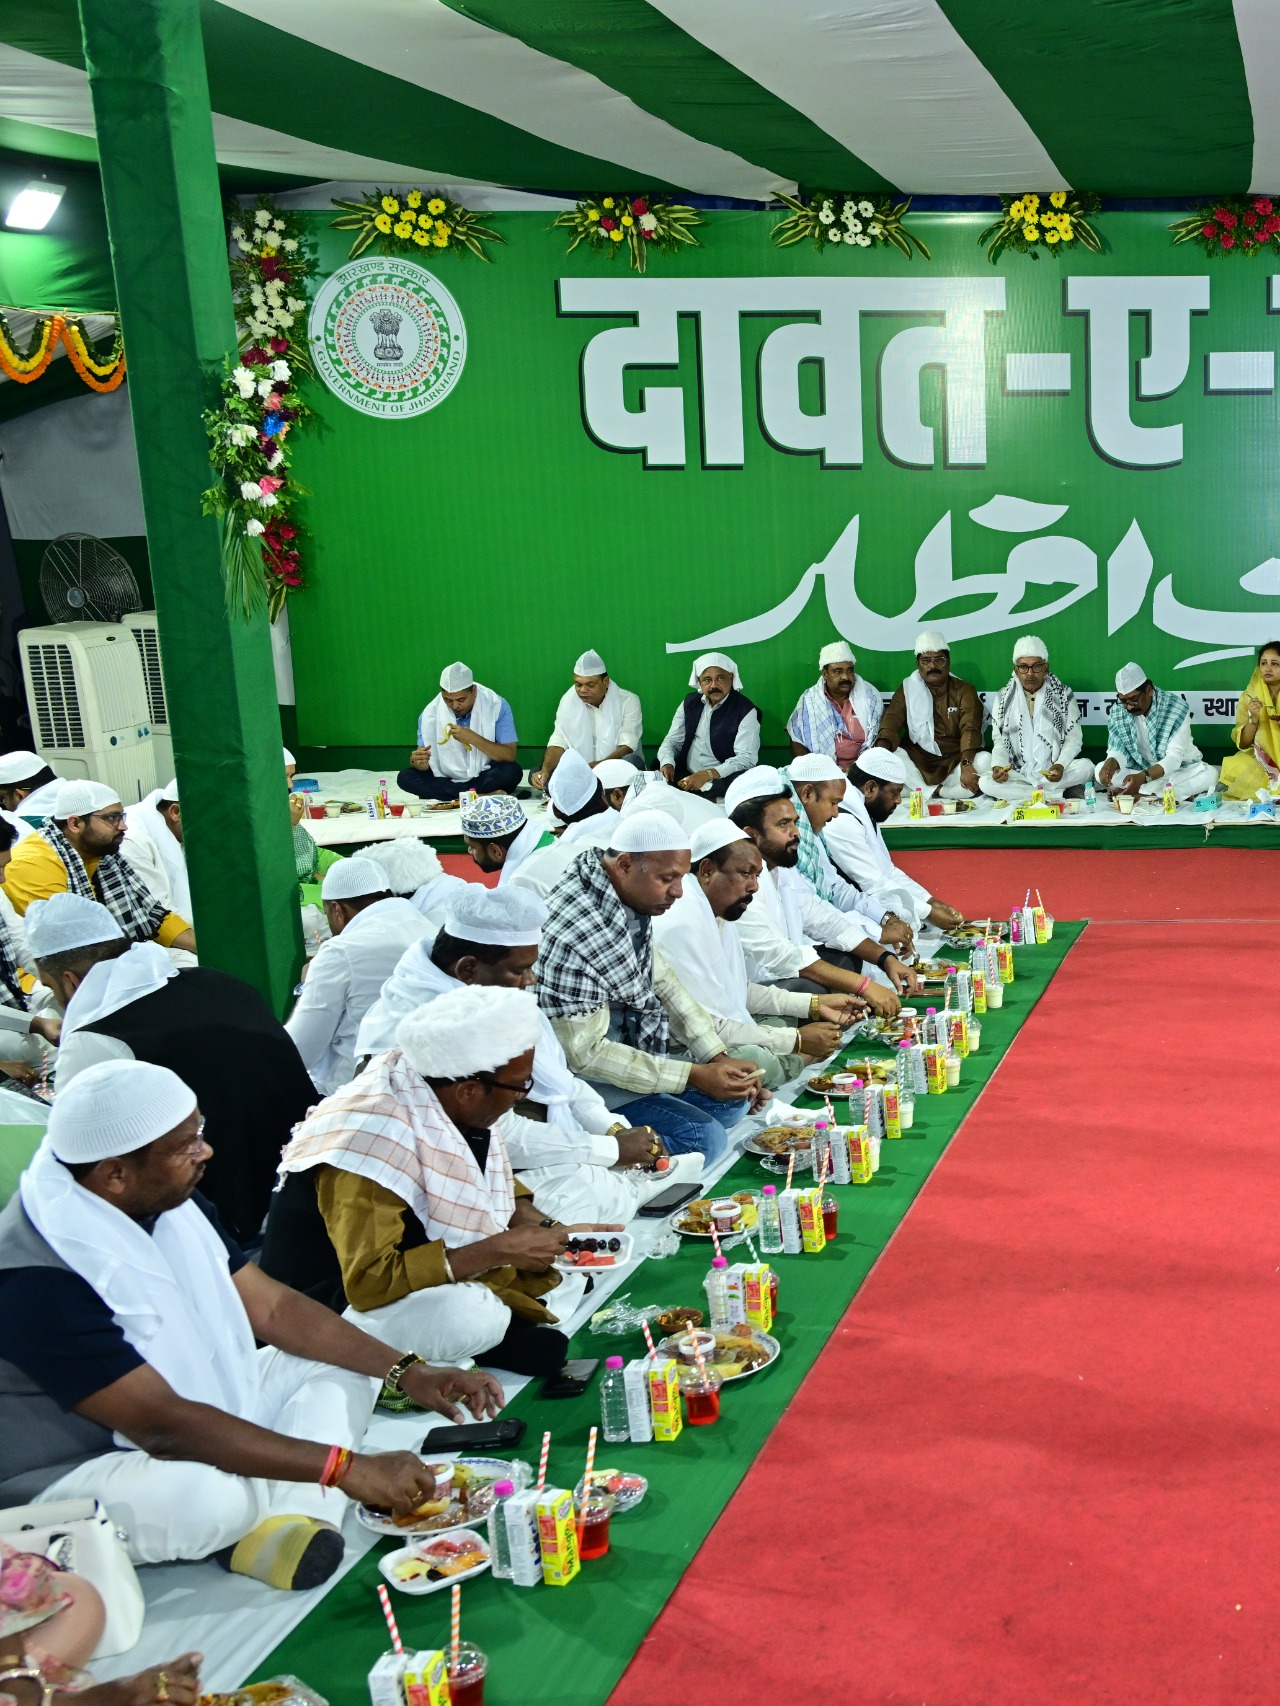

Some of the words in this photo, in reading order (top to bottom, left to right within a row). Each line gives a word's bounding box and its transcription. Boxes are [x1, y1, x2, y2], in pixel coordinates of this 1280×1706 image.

[388, 262, 431, 287] सरकार
[317, 350, 387, 413] GOVERNMENT
[391, 404, 405, 413] OF
[409, 350, 461, 412] JHARKHAND
